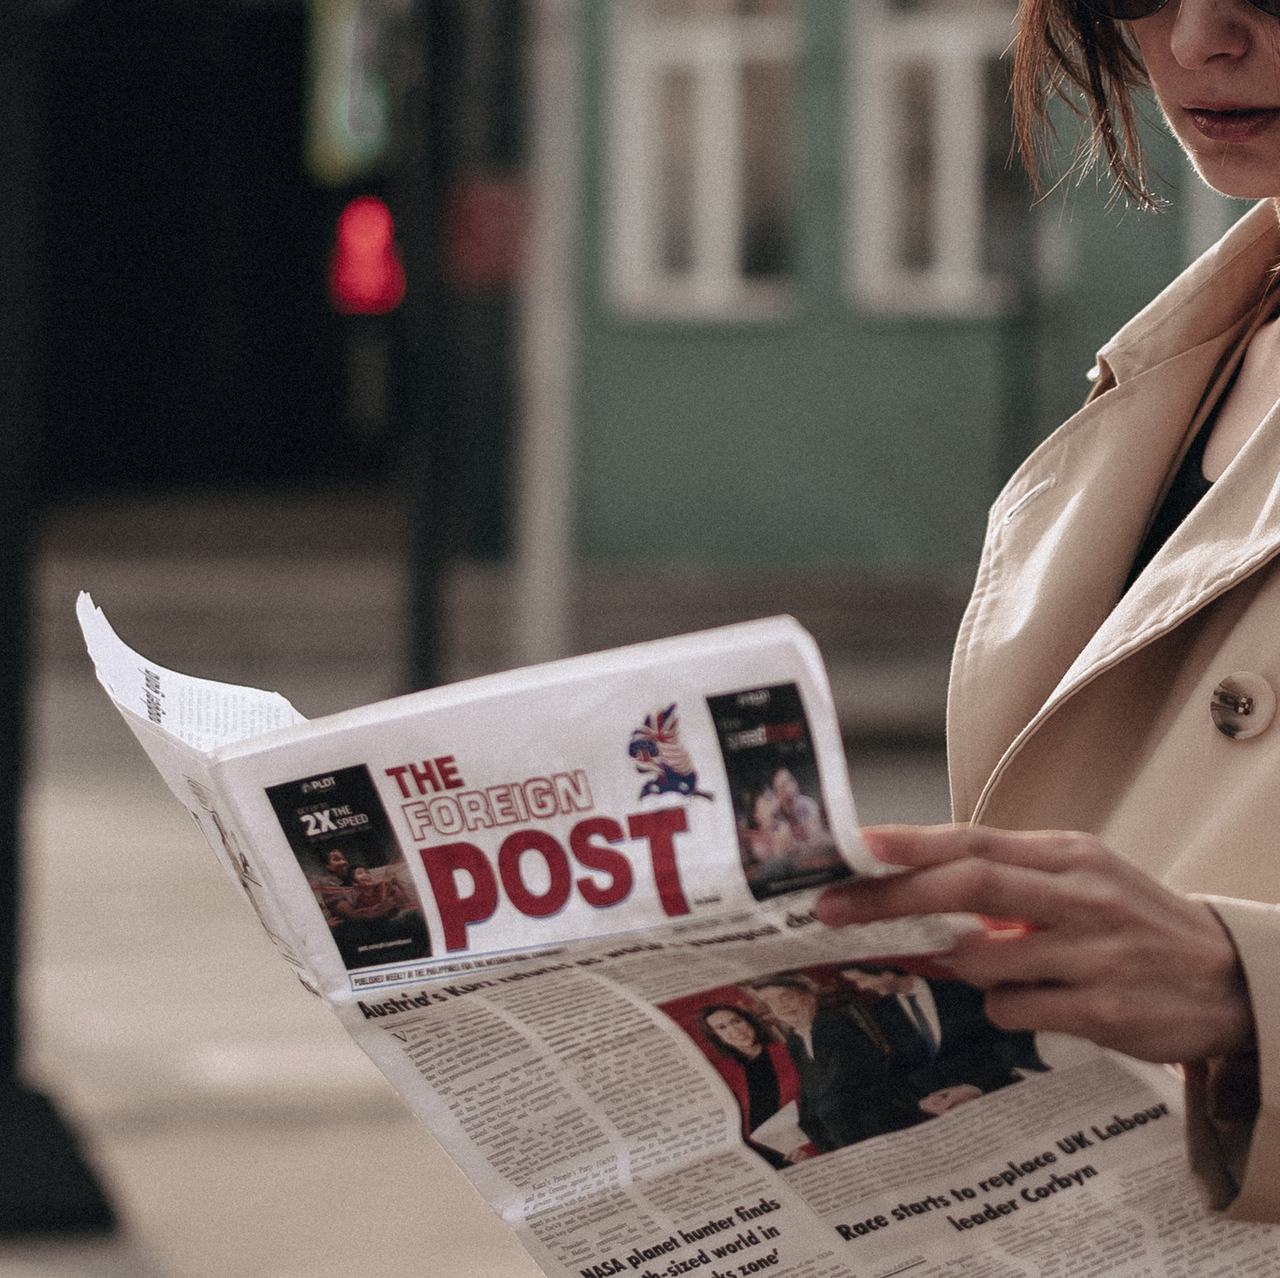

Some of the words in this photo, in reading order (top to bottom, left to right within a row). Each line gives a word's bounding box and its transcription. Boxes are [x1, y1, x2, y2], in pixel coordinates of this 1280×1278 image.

[312, 776, 336, 790] PLDT
[384, 755, 465, 799] THE
[300, 809, 338, 837] 2X
[330, 805, 354, 818] THE
[337, 813, 369, 829] SPEED
[401, 769, 595, 842] FOREIGN
[419, 806, 692, 954] POST
[354, 974, 385, 987] PUBLISHED
[357, 990, 448, 1020] Austria's
[443, 978, 495, 998] Kurz
[834, 1213, 890, 1242] Race
[891, 1191, 952, 1222] starts
[950, 1185, 977, 1203] to
[978, 1150, 1058, 1193] replace
[1055, 1130, 1094, 1156] UK
[1090, 1101, 1170, 1141] Labour
[946, 1197, 1021, 1232] leader
[1020, 1162, 1099, 1203] Corbyn
[626, 1235, 681, 1269] planet
[677, 1216, 736, 1244] hunter
[734, 1198, 781, 1222] finds
[711, 1229, 761, 1259] world
[757, 1225, 781, 1241] in
